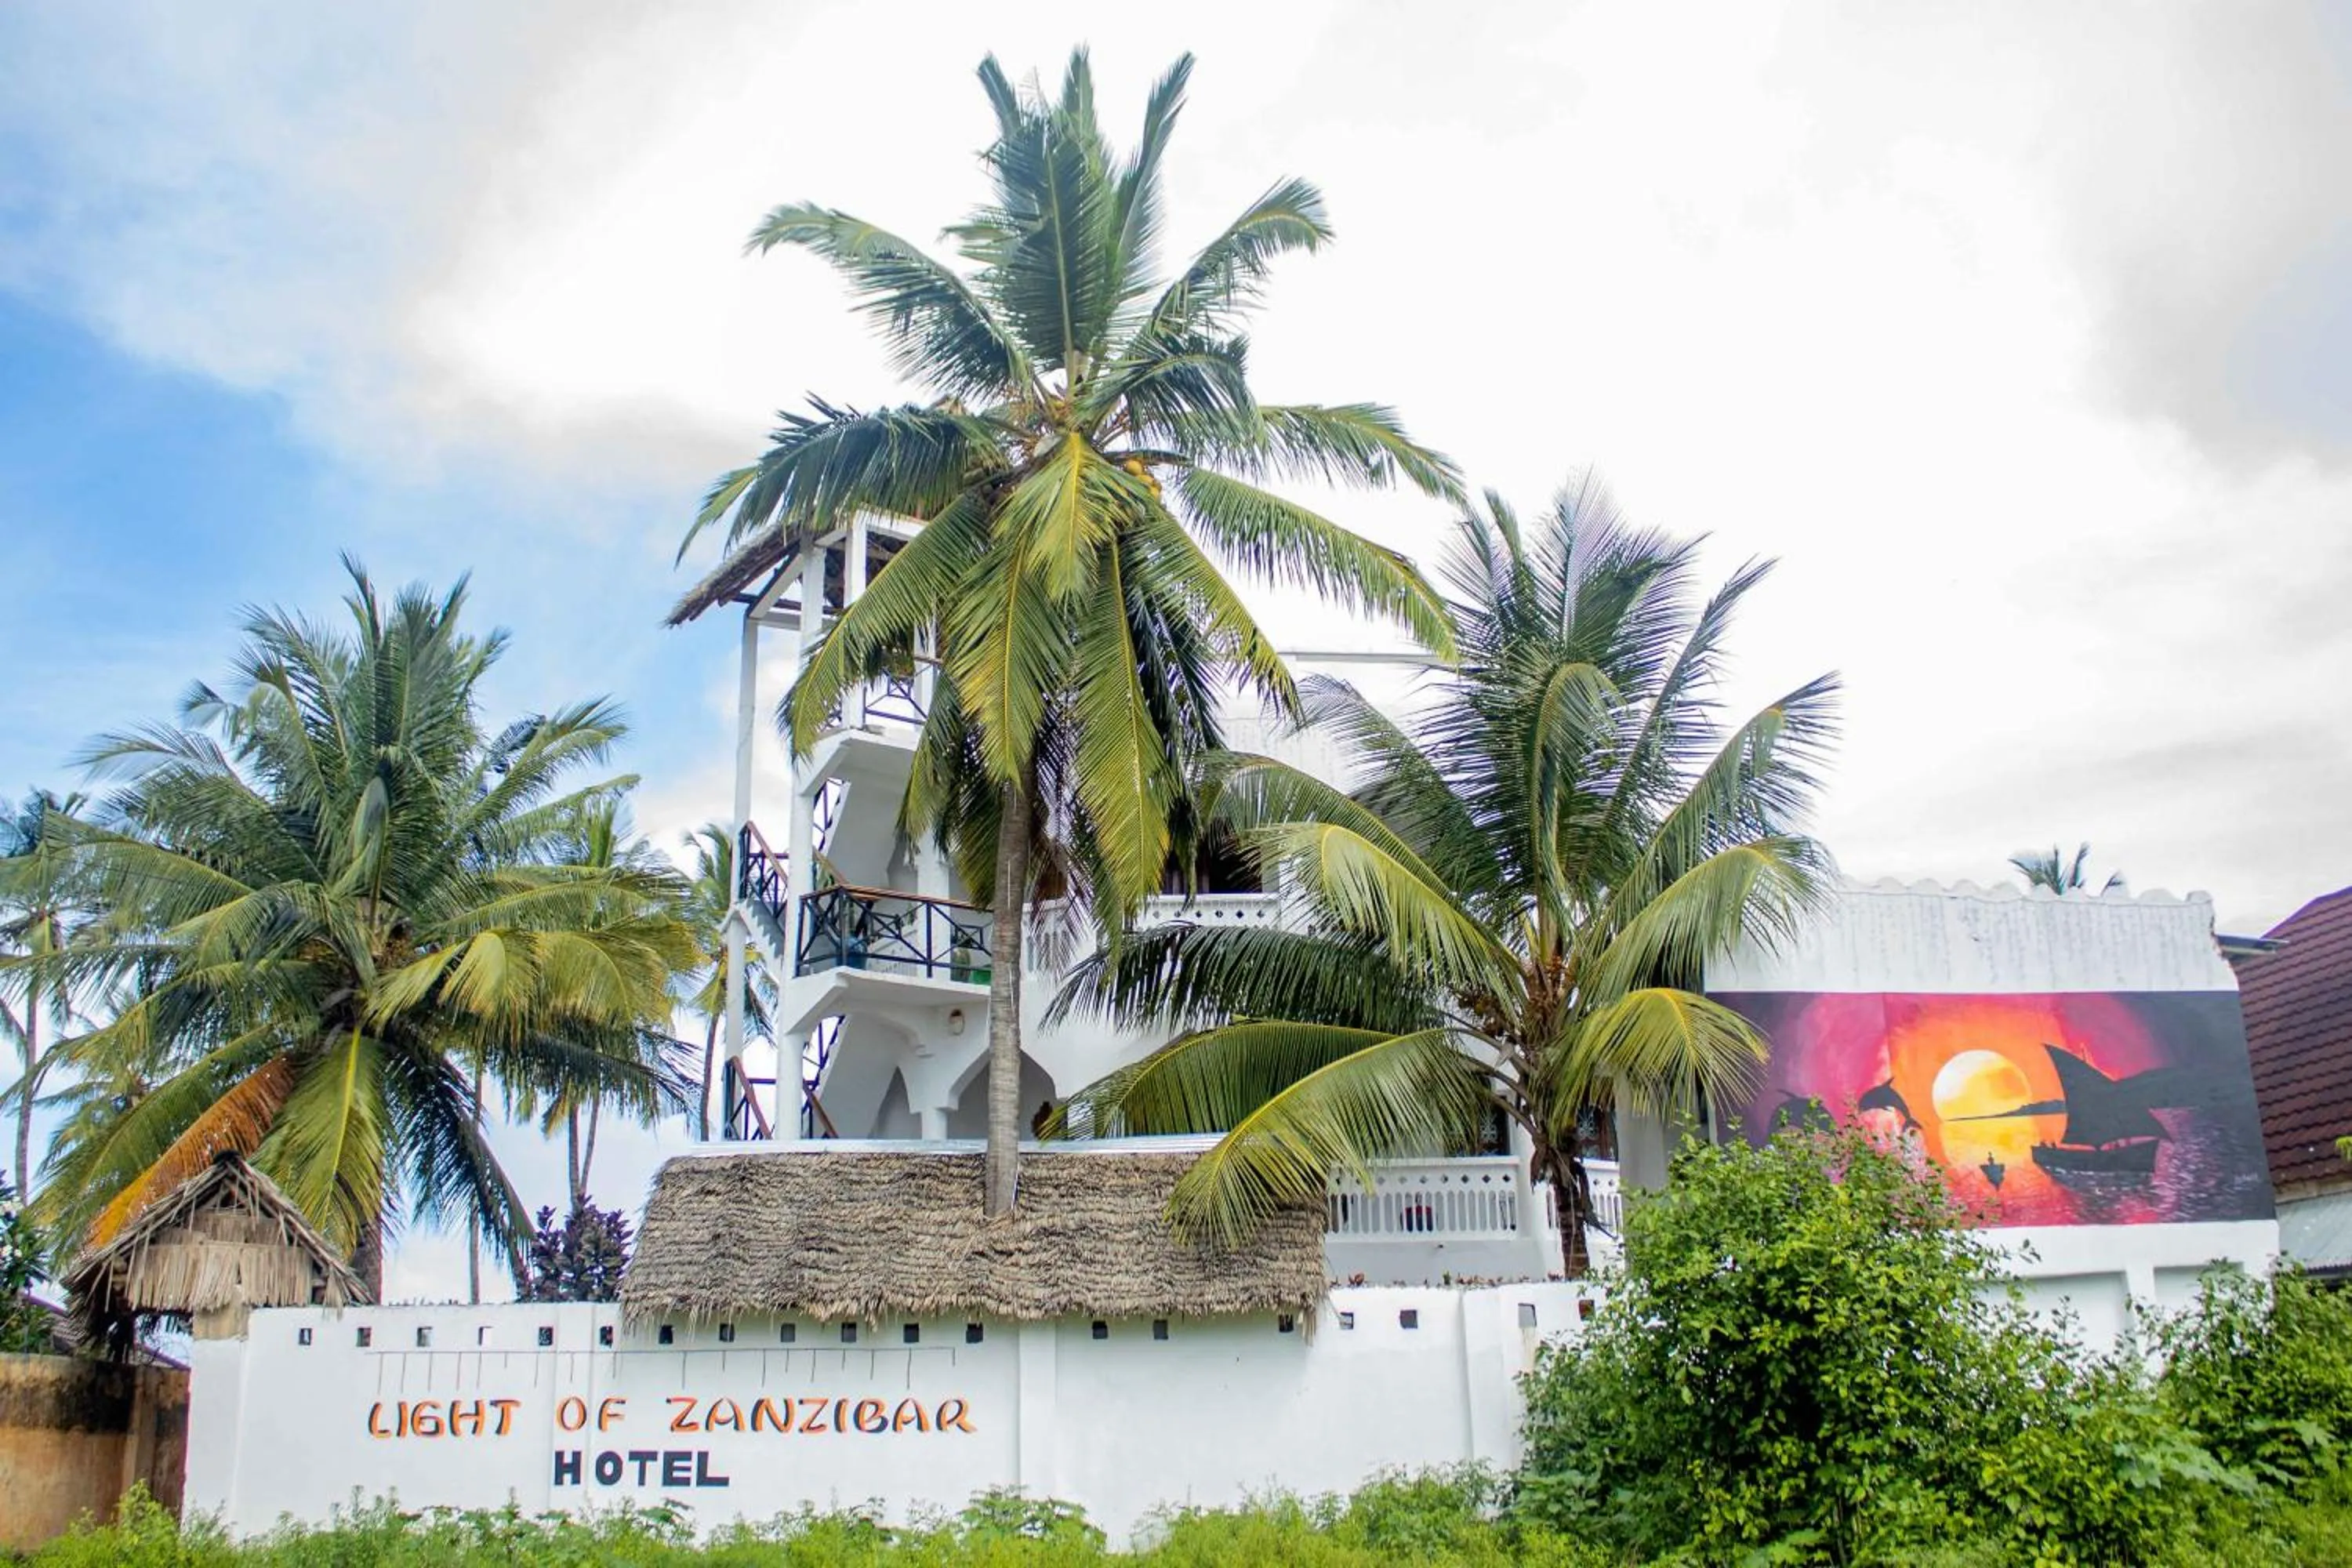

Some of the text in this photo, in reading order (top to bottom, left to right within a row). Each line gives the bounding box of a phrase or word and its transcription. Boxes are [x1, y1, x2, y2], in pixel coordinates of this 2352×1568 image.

[368, 1396, 977, 1438] LIGHT OF ZANZIBAR
[554, 1450, 730, 1487] HOTEL
